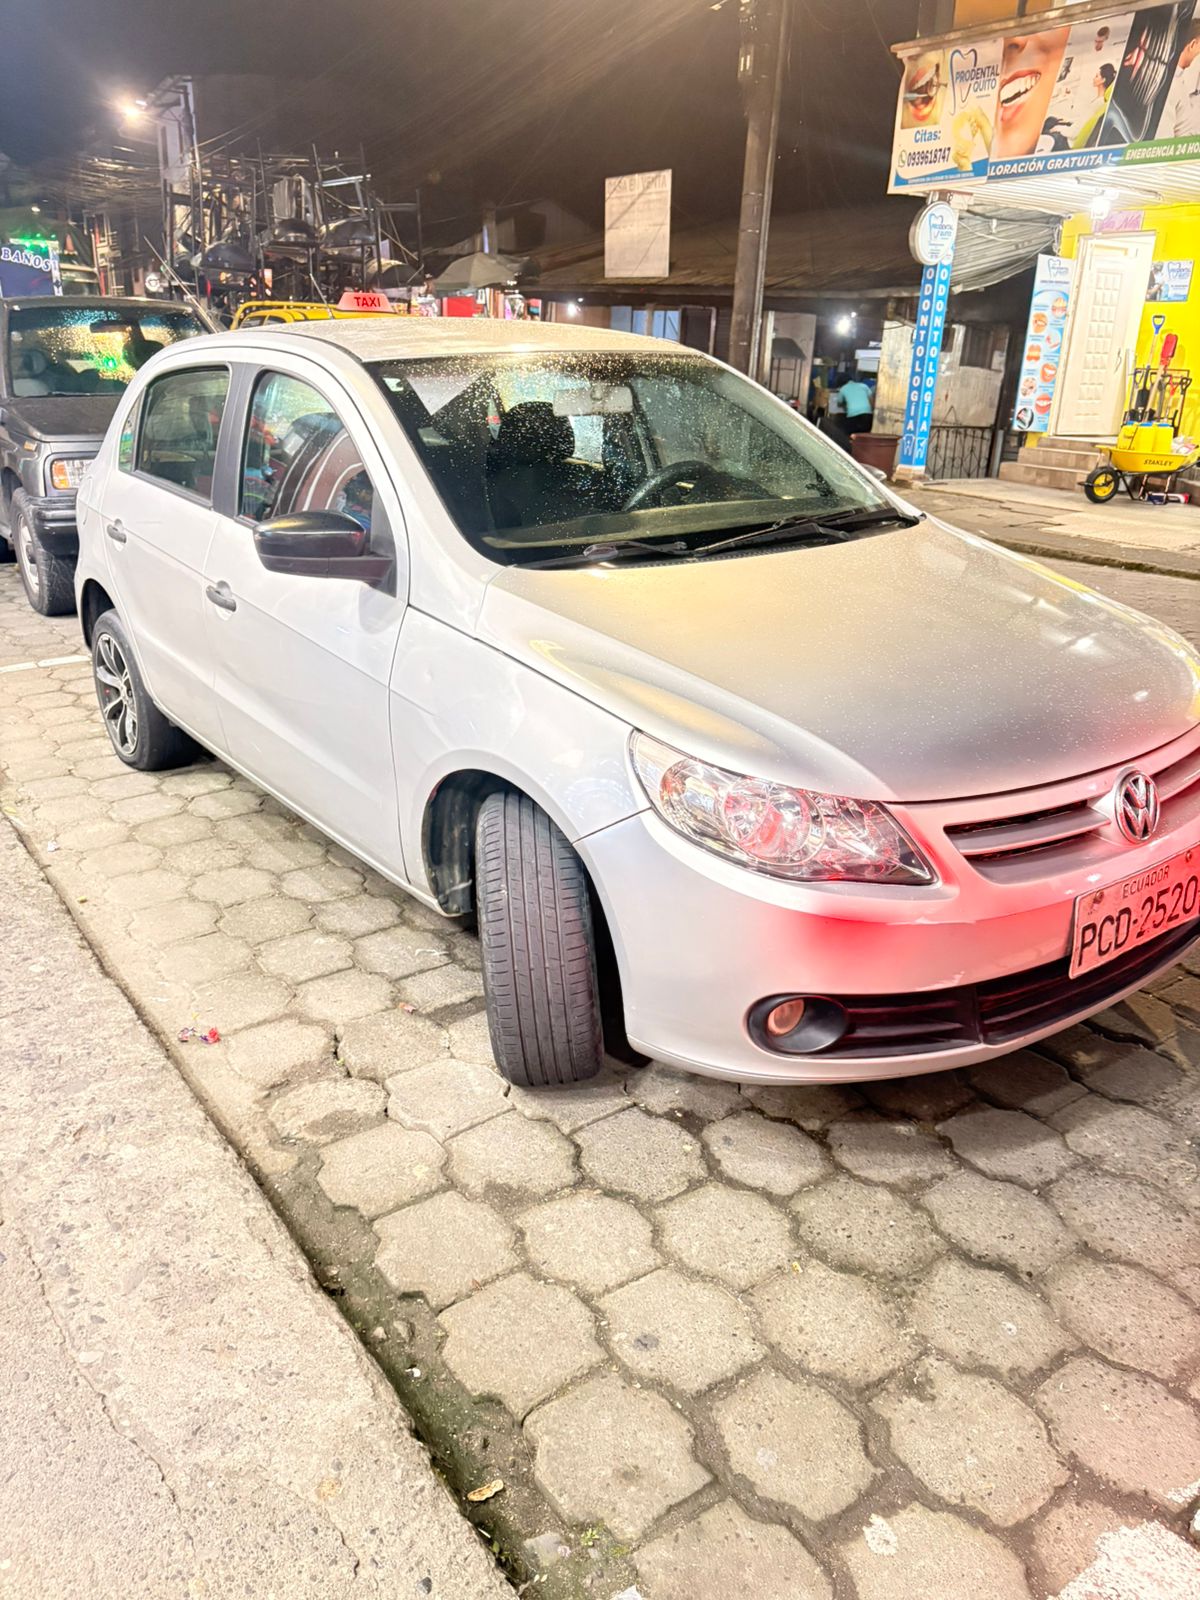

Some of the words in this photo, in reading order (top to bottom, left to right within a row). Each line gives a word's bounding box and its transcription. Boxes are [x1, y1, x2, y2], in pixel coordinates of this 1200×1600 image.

[955, 64, 1000, 82] PRODENTAL
[973, 78, 997, 92] QUITO
[914, 129, 942, 143] Citas:
[907, 147, 951, 167] 0939618747
[1125, 144, 1174, 160] EMERGENCIA
[1174, 143, 1187, 156] 24
[1186, 141, 1200, 154] HO
[988, 158, 1046, 176] LORACIÓN
[1047, 153, 1103, 170] GRATUITA
[353, 296, 381, 308] TAXI
[1143, 459, 1174, 467] STANLEY
[1122, 865, 1170, 899] ECUADOR
[1077, 875, 1198, 967] PCD-2520
